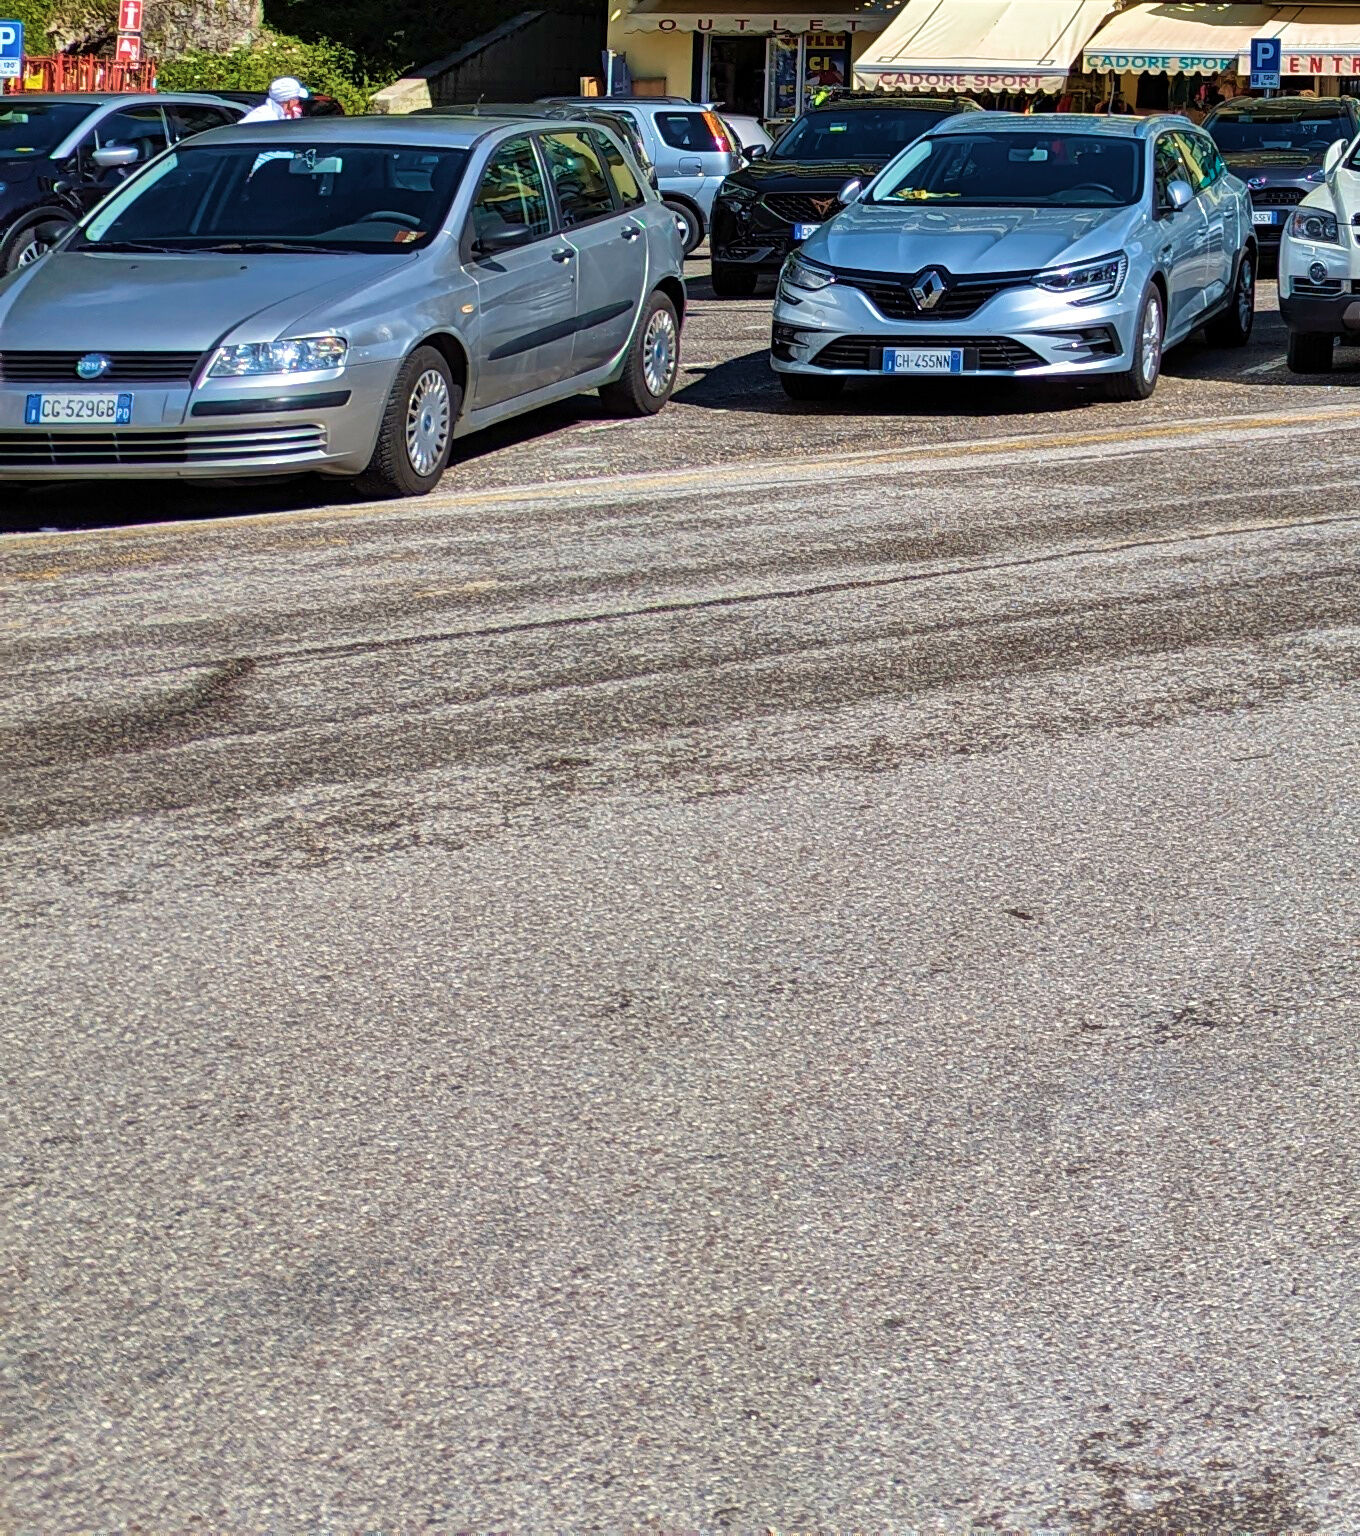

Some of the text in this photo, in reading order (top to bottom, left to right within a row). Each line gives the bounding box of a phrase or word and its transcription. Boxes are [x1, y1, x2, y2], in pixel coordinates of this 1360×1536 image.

[658, 19, 862, 31] OUTLET
[1086, 55, 1233, 70] CADORE SPOR
[1257, 43, 1274, 68] P
[880, 73, 1043, 89] CADORE SPORT
